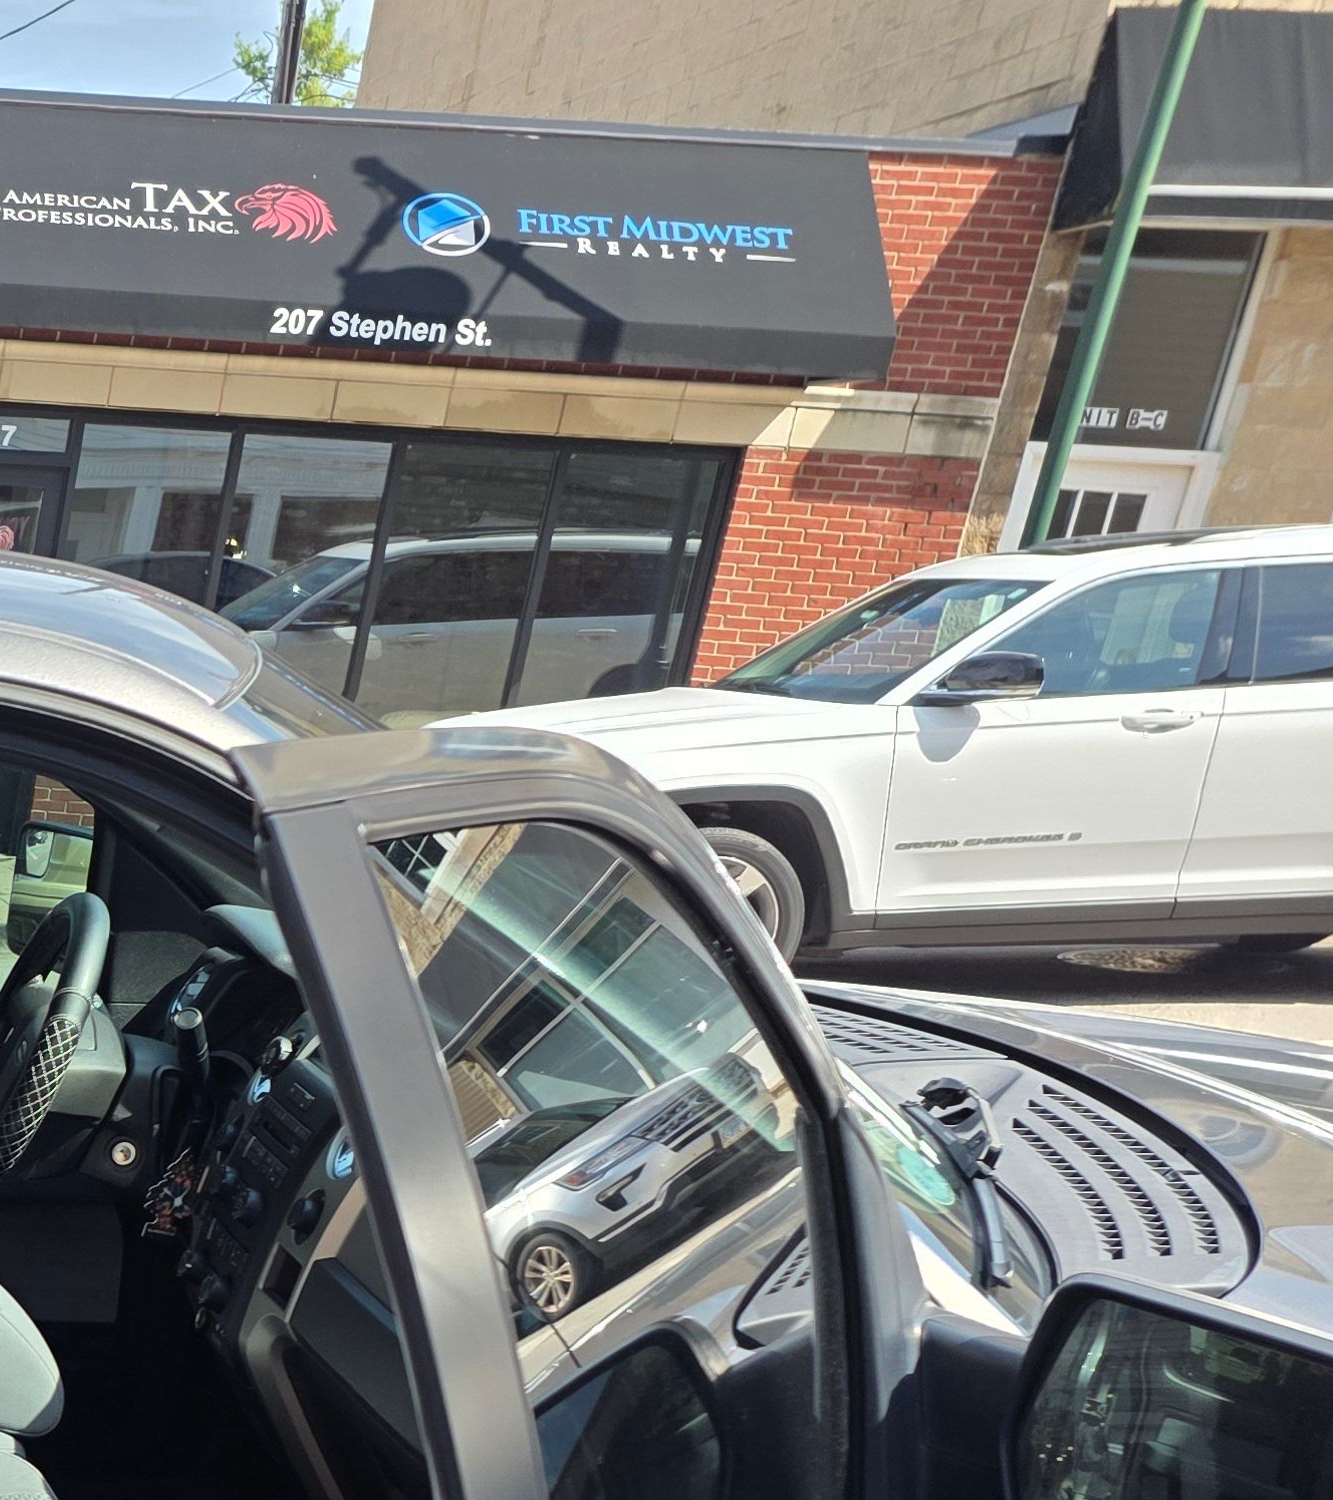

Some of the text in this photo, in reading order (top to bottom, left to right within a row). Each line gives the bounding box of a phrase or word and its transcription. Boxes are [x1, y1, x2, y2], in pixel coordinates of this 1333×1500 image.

[3, 182, 232, 217] AMERICAN TAX
[517, 208, 793, 249] FIRST MIDWEST
[577, 238, 726, 263] REALTY
[270, 308, 492, 346] 207 Stephen St.
[1081, 407, 1118, 427] NIT
